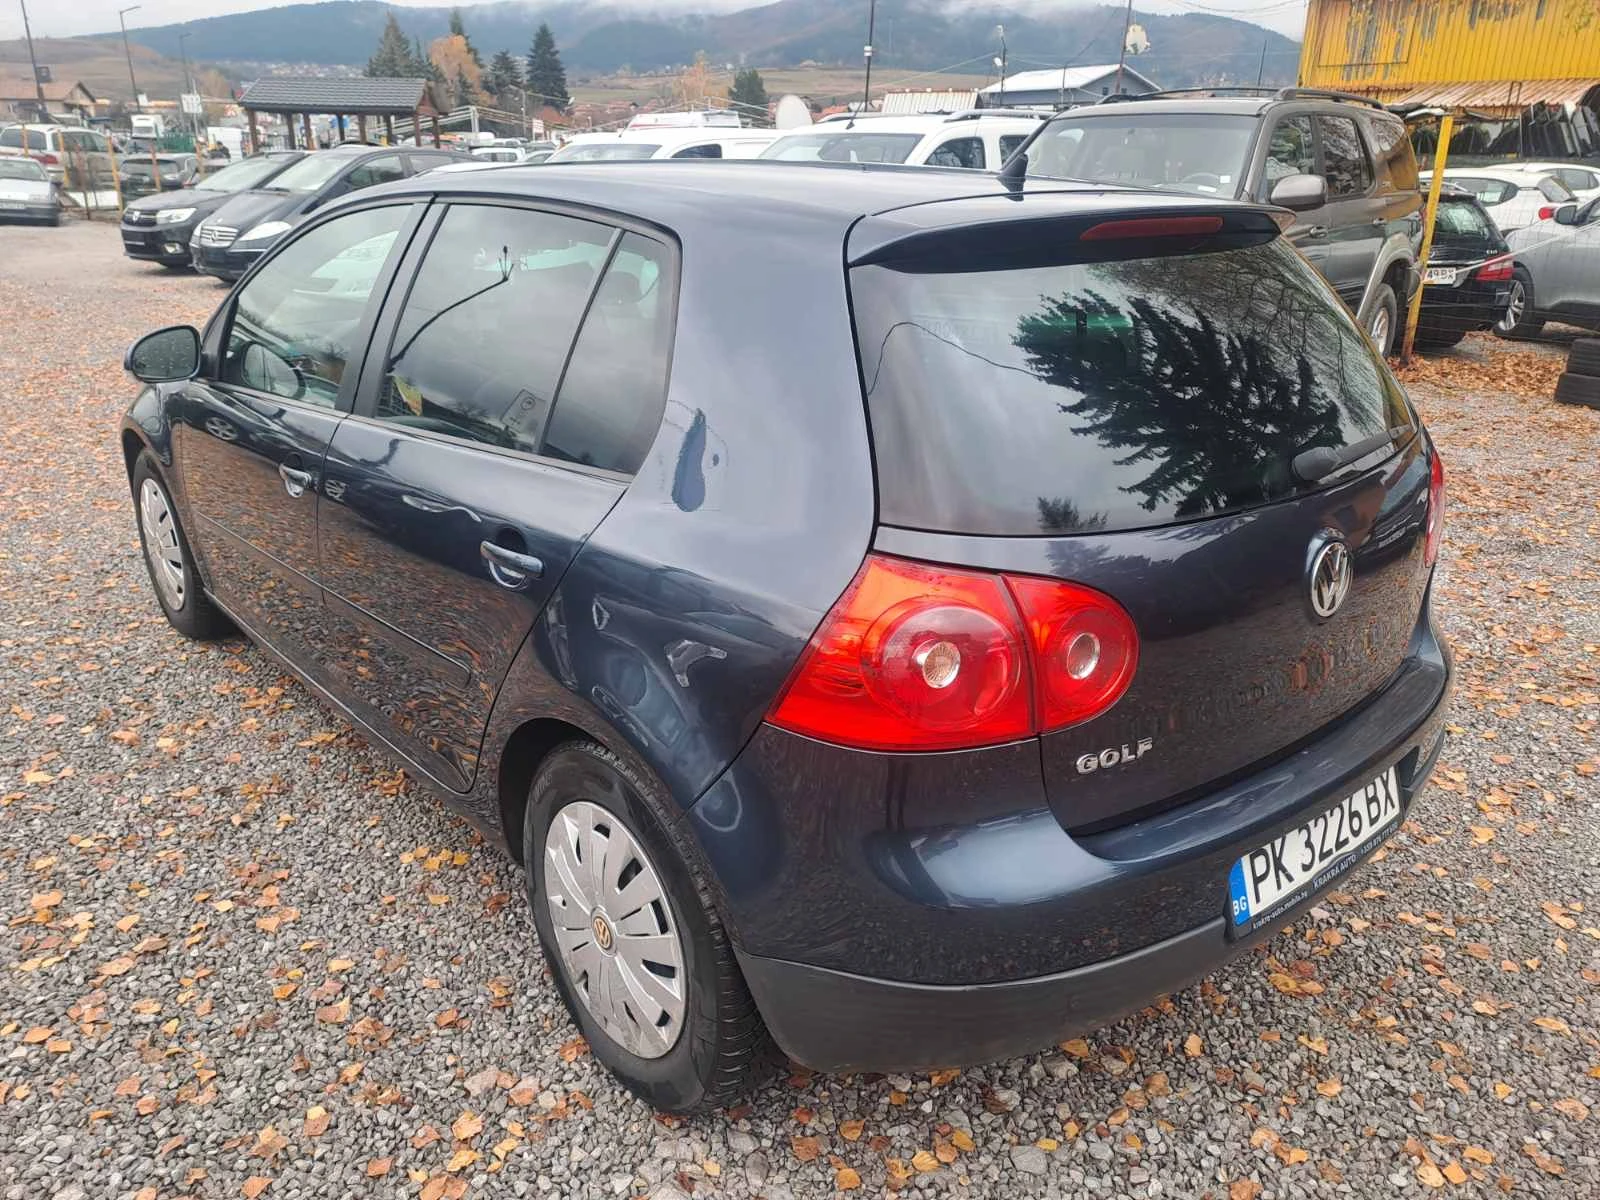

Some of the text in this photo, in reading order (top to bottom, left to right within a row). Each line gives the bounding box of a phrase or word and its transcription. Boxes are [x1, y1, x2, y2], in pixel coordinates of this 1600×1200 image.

[1076, 737, 1153, 775] GOLF
[1249, 770, 1396, 905] PK 3226 BX
[1313, 854, 1357, 889] KRAKRA AUTO
[1232, 895, 1248, 916] BG
